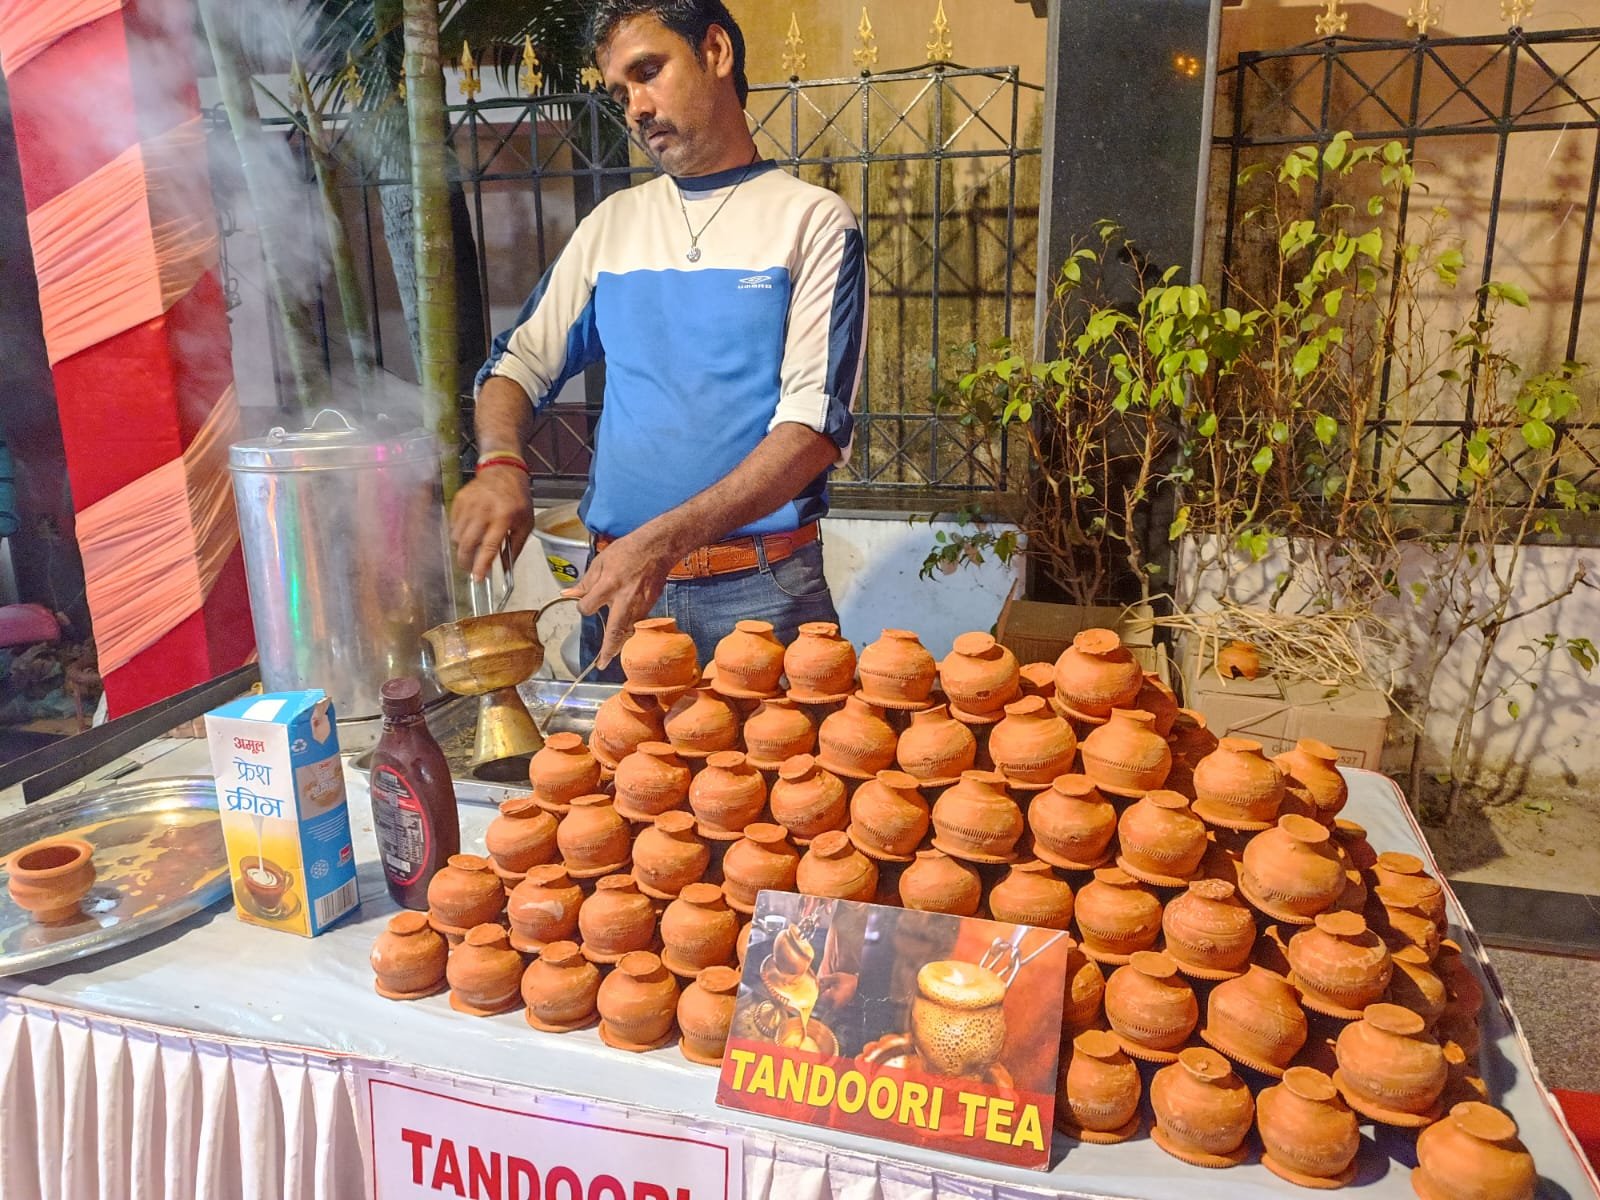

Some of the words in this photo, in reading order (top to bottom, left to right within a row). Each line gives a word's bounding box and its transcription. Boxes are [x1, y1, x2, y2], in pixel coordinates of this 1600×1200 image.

[233, 737, 265, 754] अमूल
[232, 756, 273, 786] फ्रेश
[224, 786, 285, 818] क्रीम
[730, 1048, 944, 1131] TANDOORI
[958, 1092, 1046, 1152] TEA
[401, 1128, 691, 1200] TANDO
